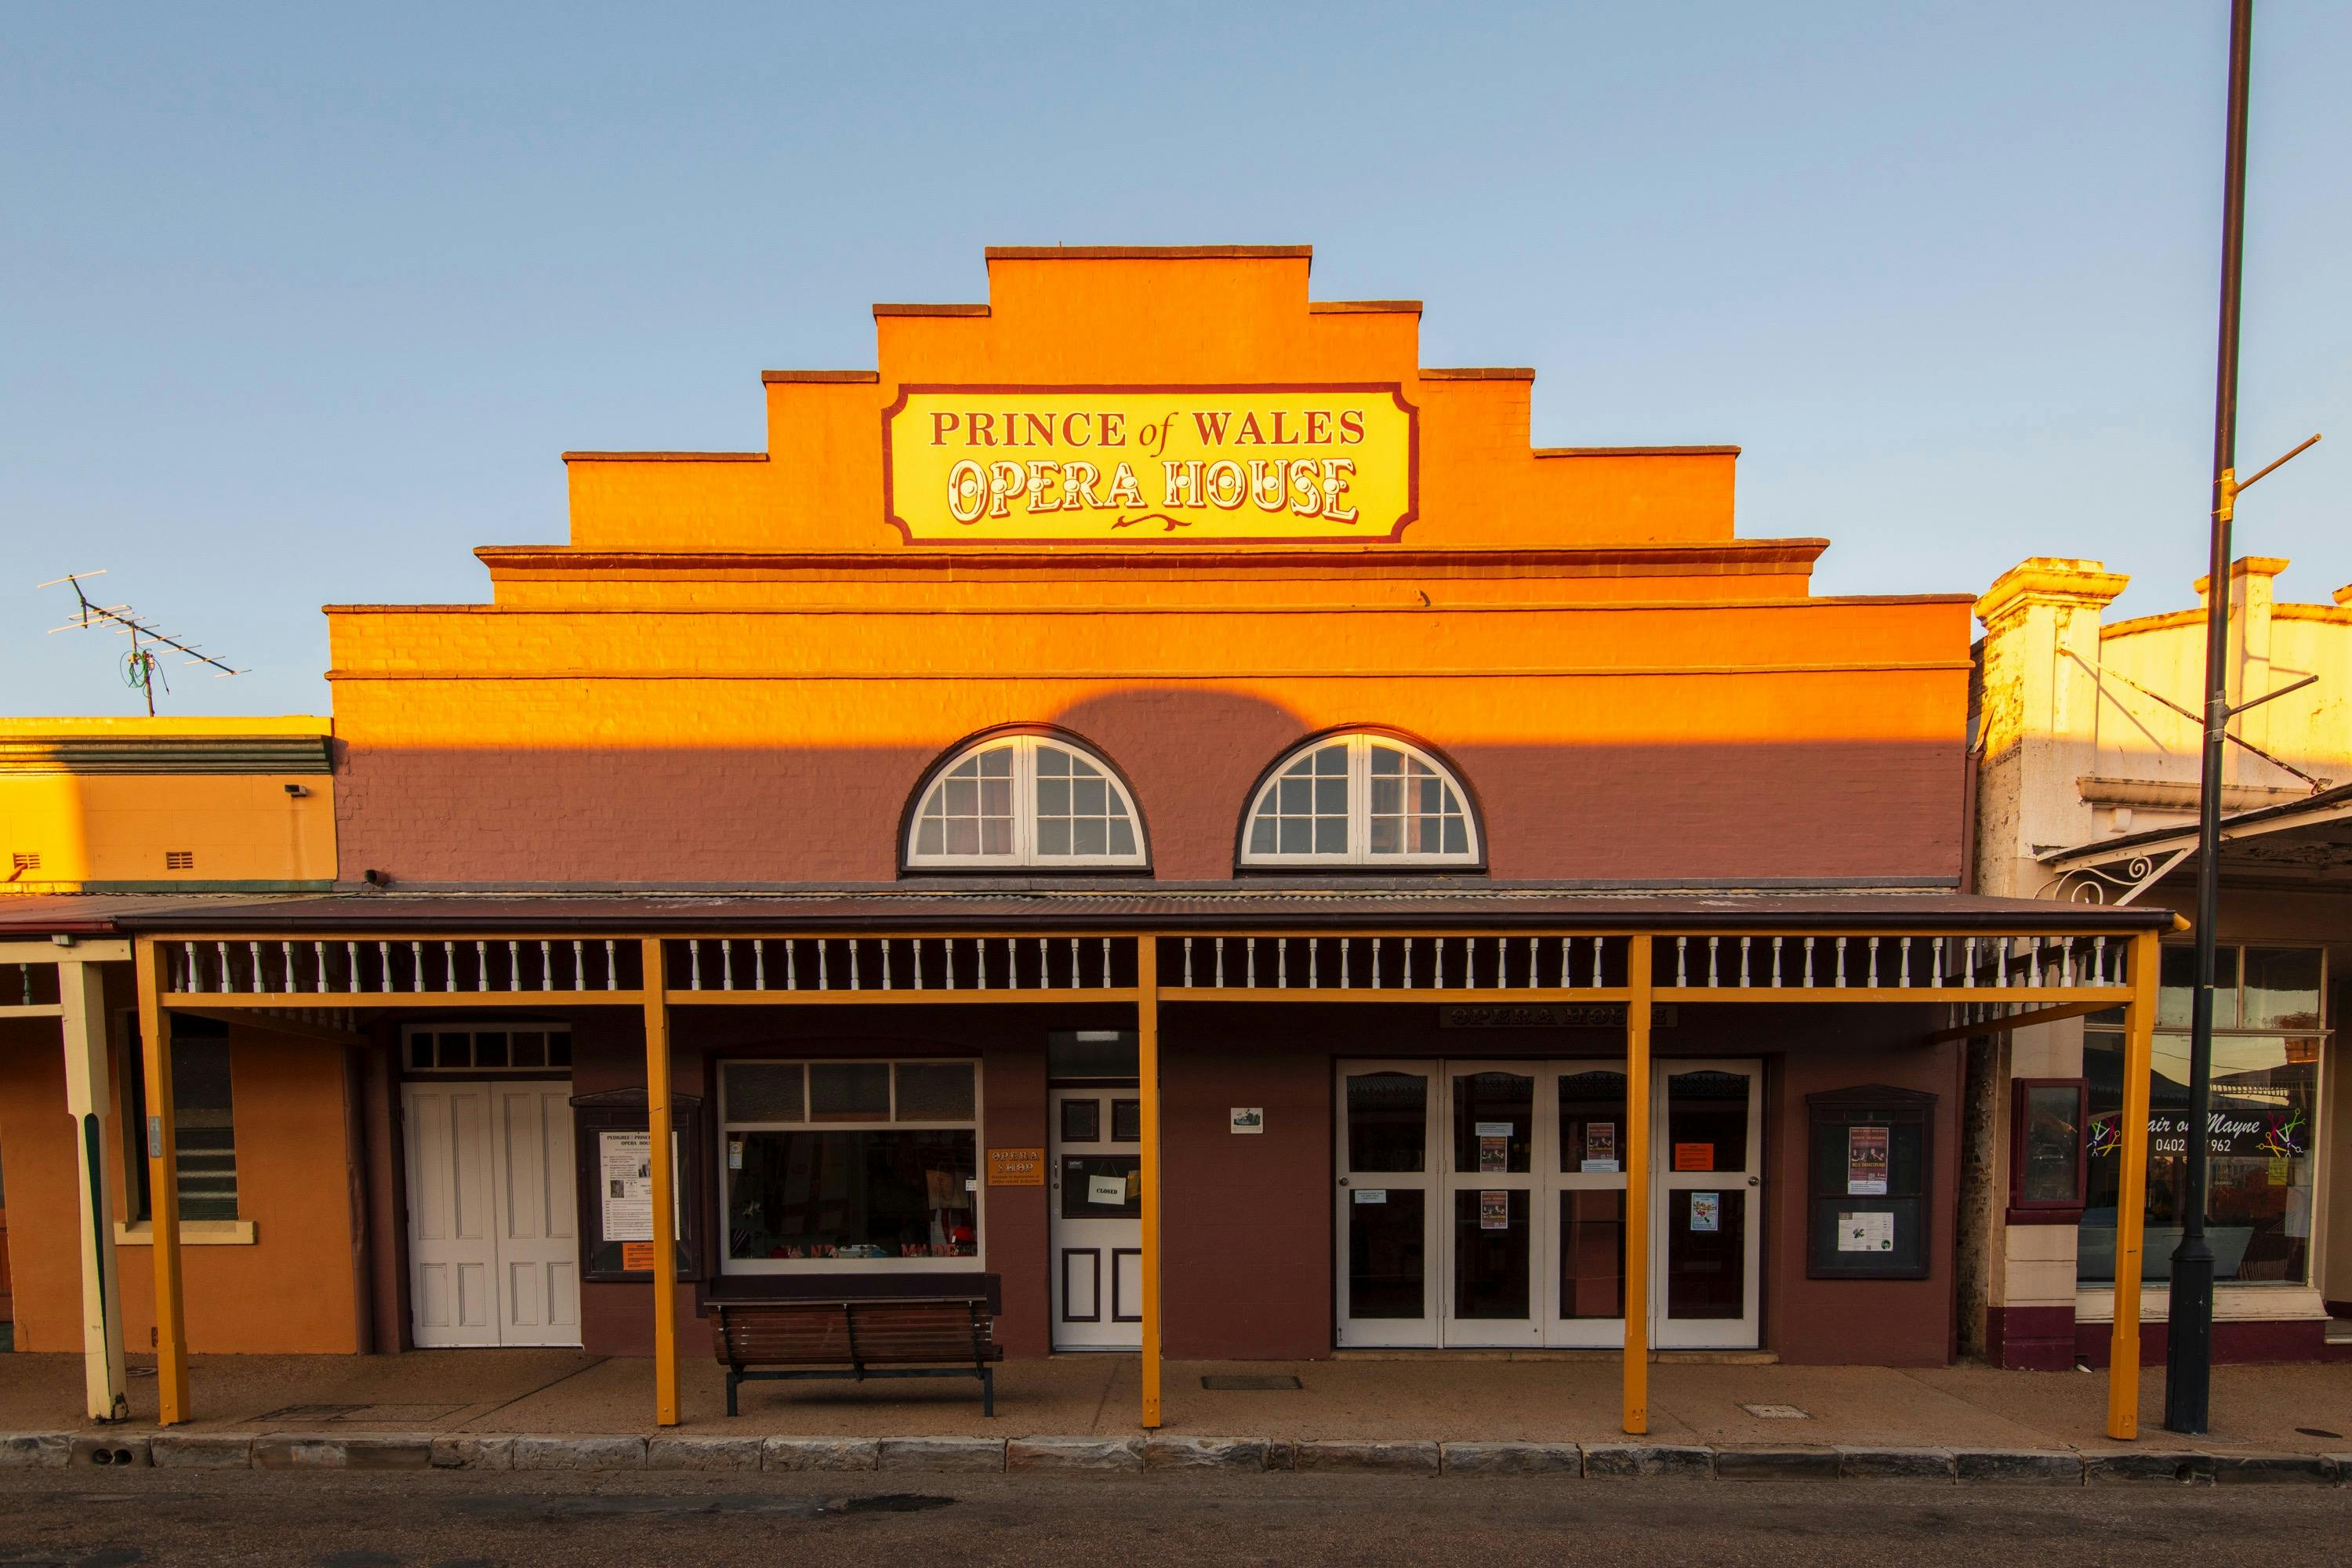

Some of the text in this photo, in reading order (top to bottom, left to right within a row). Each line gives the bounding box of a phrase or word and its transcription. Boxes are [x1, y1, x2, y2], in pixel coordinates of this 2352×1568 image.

[930, 410, 1367, 458] PRINCE of WALES
[946, 457, 1359, 524] OPERA HOUSE
[1450, 1007, 1669, 1025] OPERA HOUE
[2147, 1112, 2260, 1139] air o Mayne
[2156, 1138, 2185, 1152] 0402
[2211, 1139, 2231, 1152] 962
[992, 1151, 1040, 1161] OPERA
[998, 1163, 1034, 1173] SHOP
